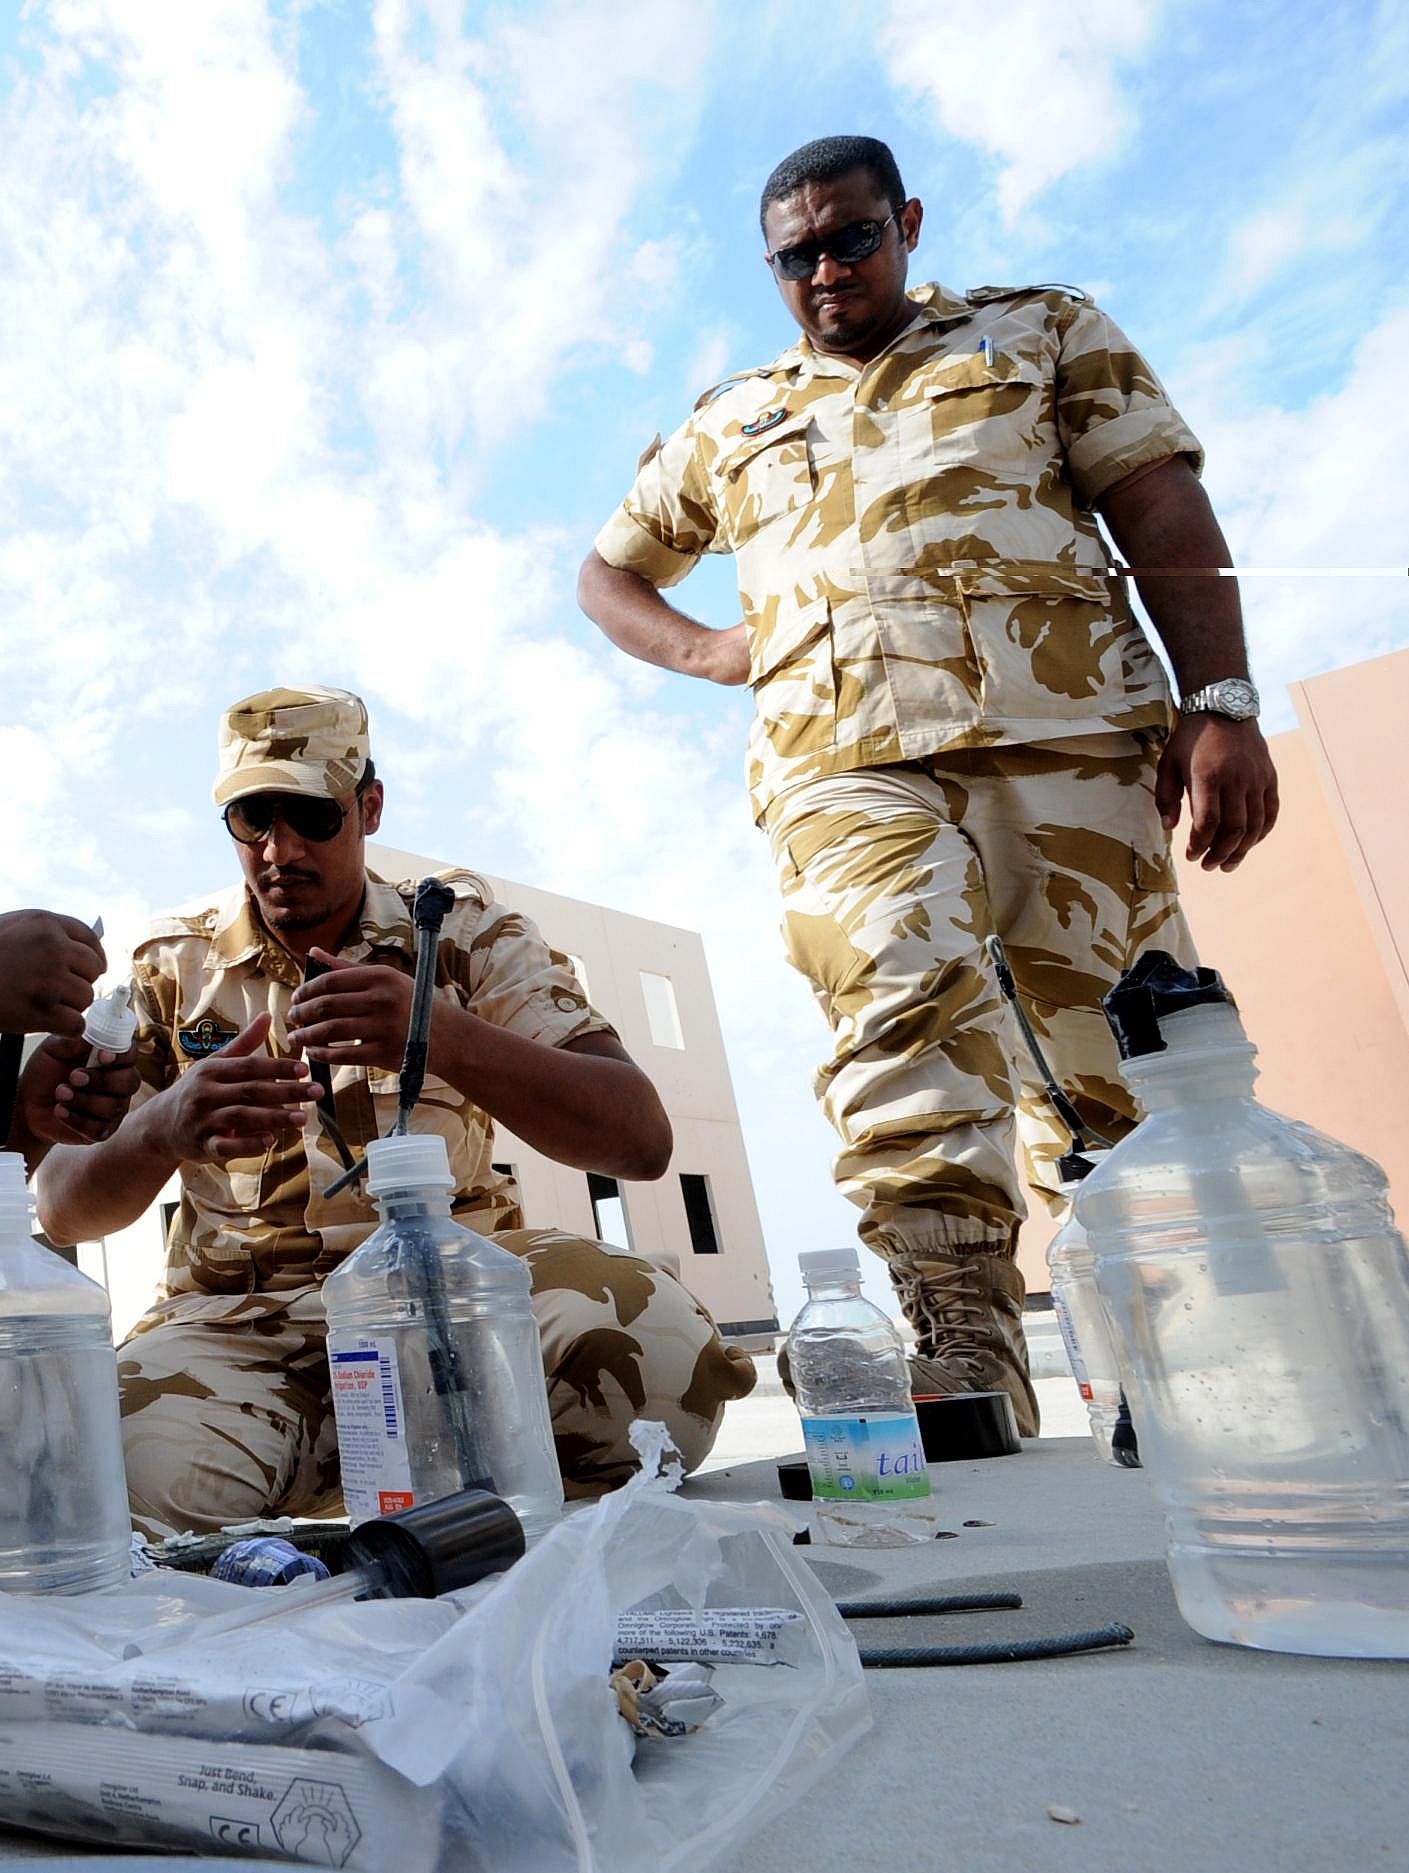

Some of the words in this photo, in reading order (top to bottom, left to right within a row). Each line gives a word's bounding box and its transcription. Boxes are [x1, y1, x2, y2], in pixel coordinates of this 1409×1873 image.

[199, 1764, 222, 1778] Just
[224, 1768, 257, 1784] Bend,
[177, 1774, 209, 1792] Snap,
[211, 1781, 235, 1794] and
[236, 1783, 277, 1802] Shake.
